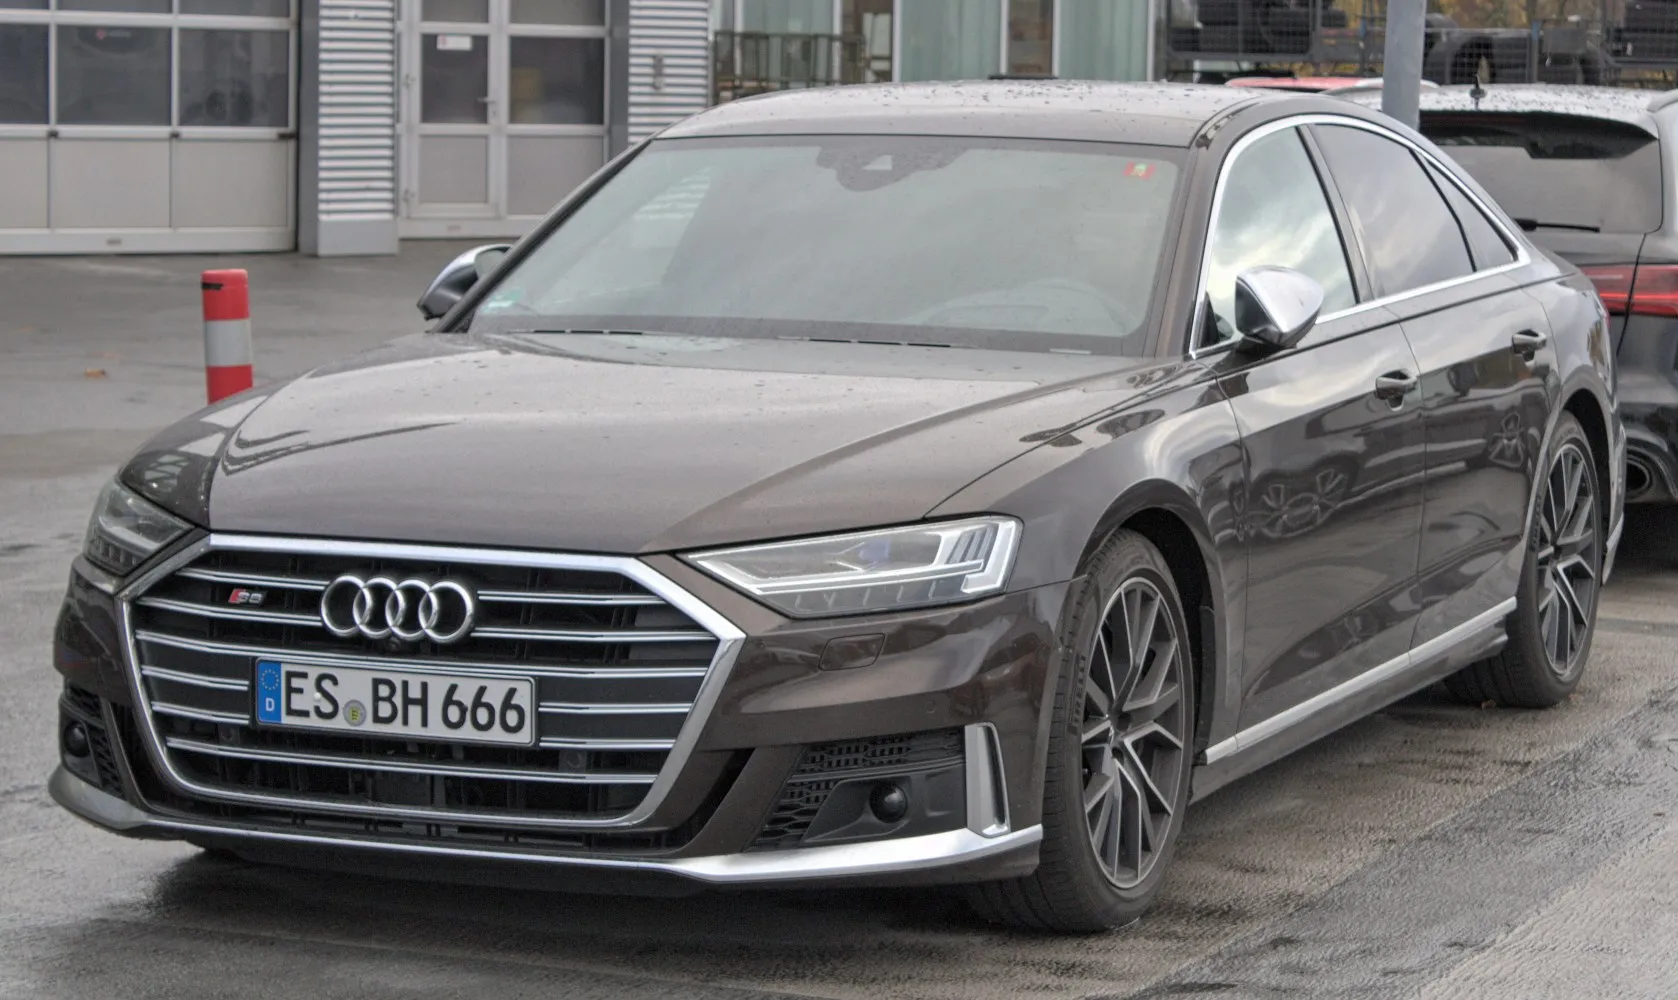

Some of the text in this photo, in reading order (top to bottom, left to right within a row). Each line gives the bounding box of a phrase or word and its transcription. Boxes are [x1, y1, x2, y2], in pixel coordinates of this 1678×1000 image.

[265, 697, 275, 711] D
[285, 670, 525, 733] ES BH 666
